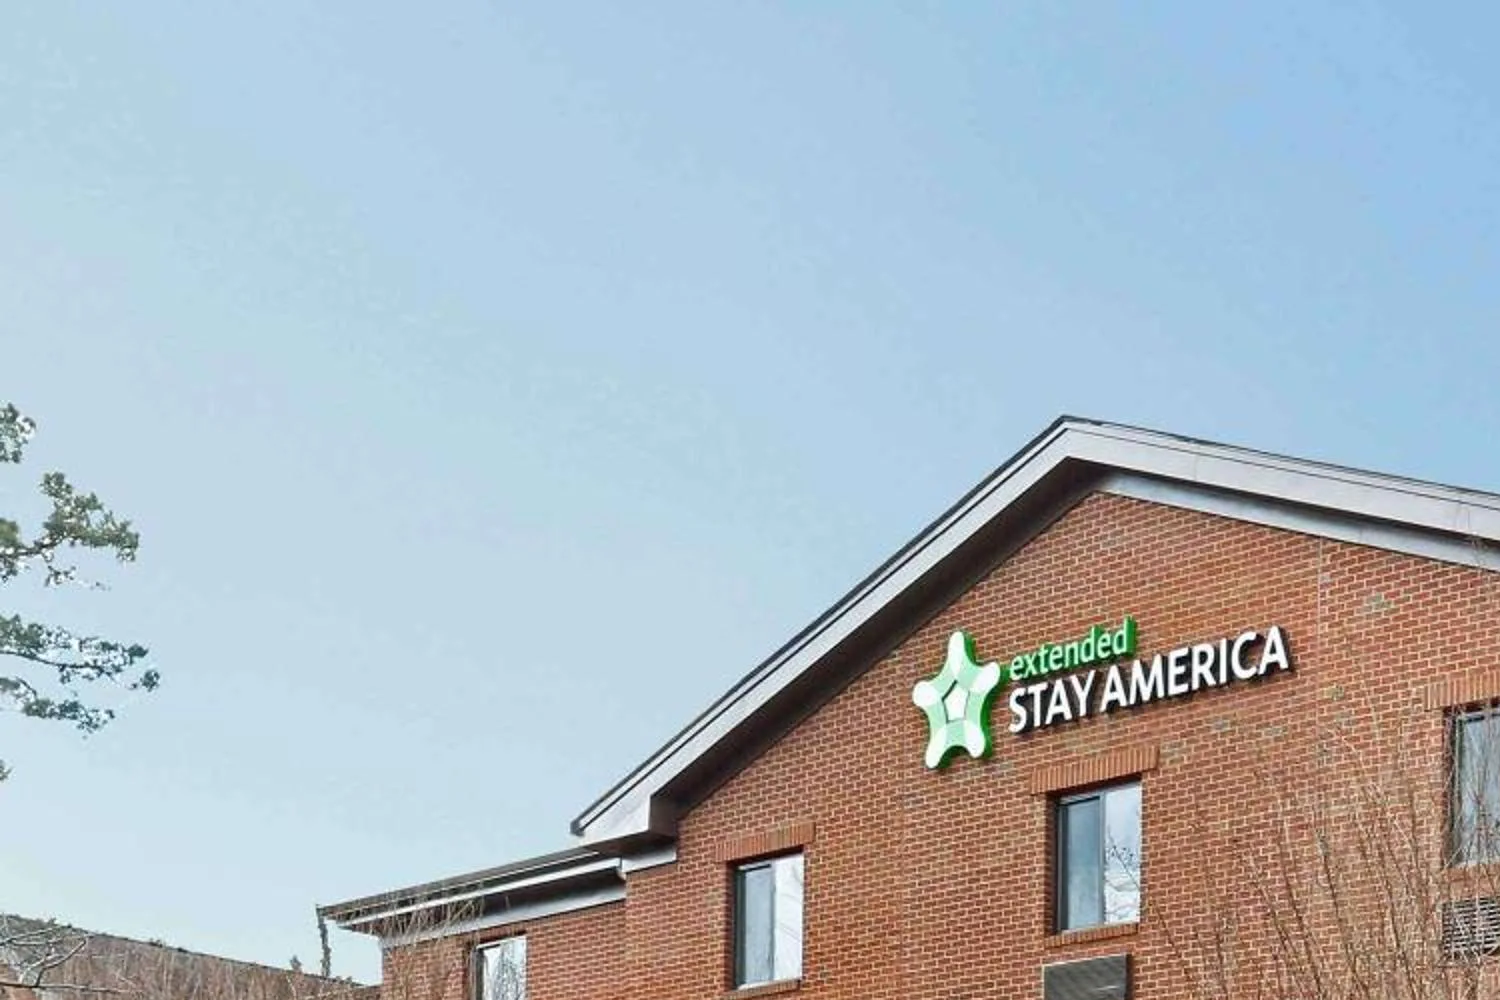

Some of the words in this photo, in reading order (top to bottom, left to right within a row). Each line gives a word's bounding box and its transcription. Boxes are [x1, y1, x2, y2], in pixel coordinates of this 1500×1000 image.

[1009, 616, 1132, 681] extended
[1009, 669, 1095, 733] STAY
[1101, 625, 1290, 711] AMERICA
